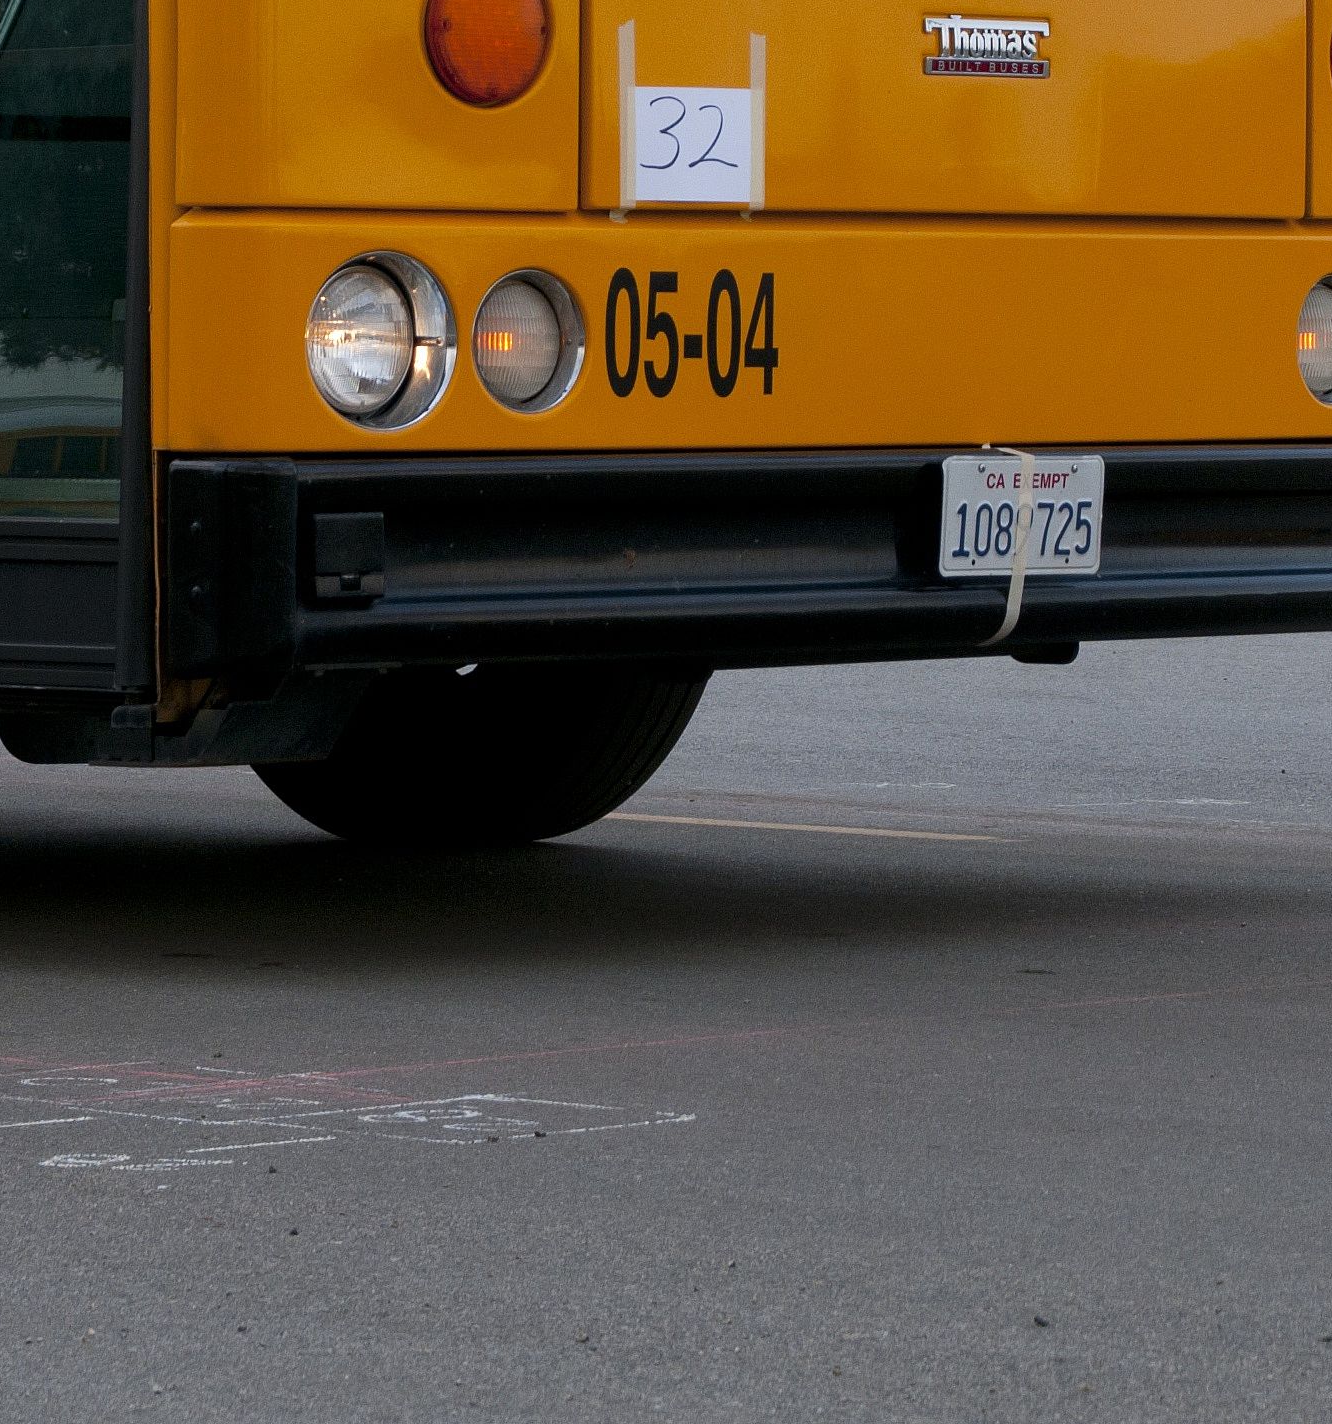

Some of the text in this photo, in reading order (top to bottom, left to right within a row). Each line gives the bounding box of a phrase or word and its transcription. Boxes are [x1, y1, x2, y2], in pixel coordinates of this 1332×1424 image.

[923, 14, 1051, 59] Thomas
[937, 60, 1041, 74] BUILT BUSES
[639, 95, 739, 170] 32
[604, 267, 780, 399] 05-04
[986, 472, 1070, 489] CA EEMPT
[951, 500, 1093, 558] 108725
